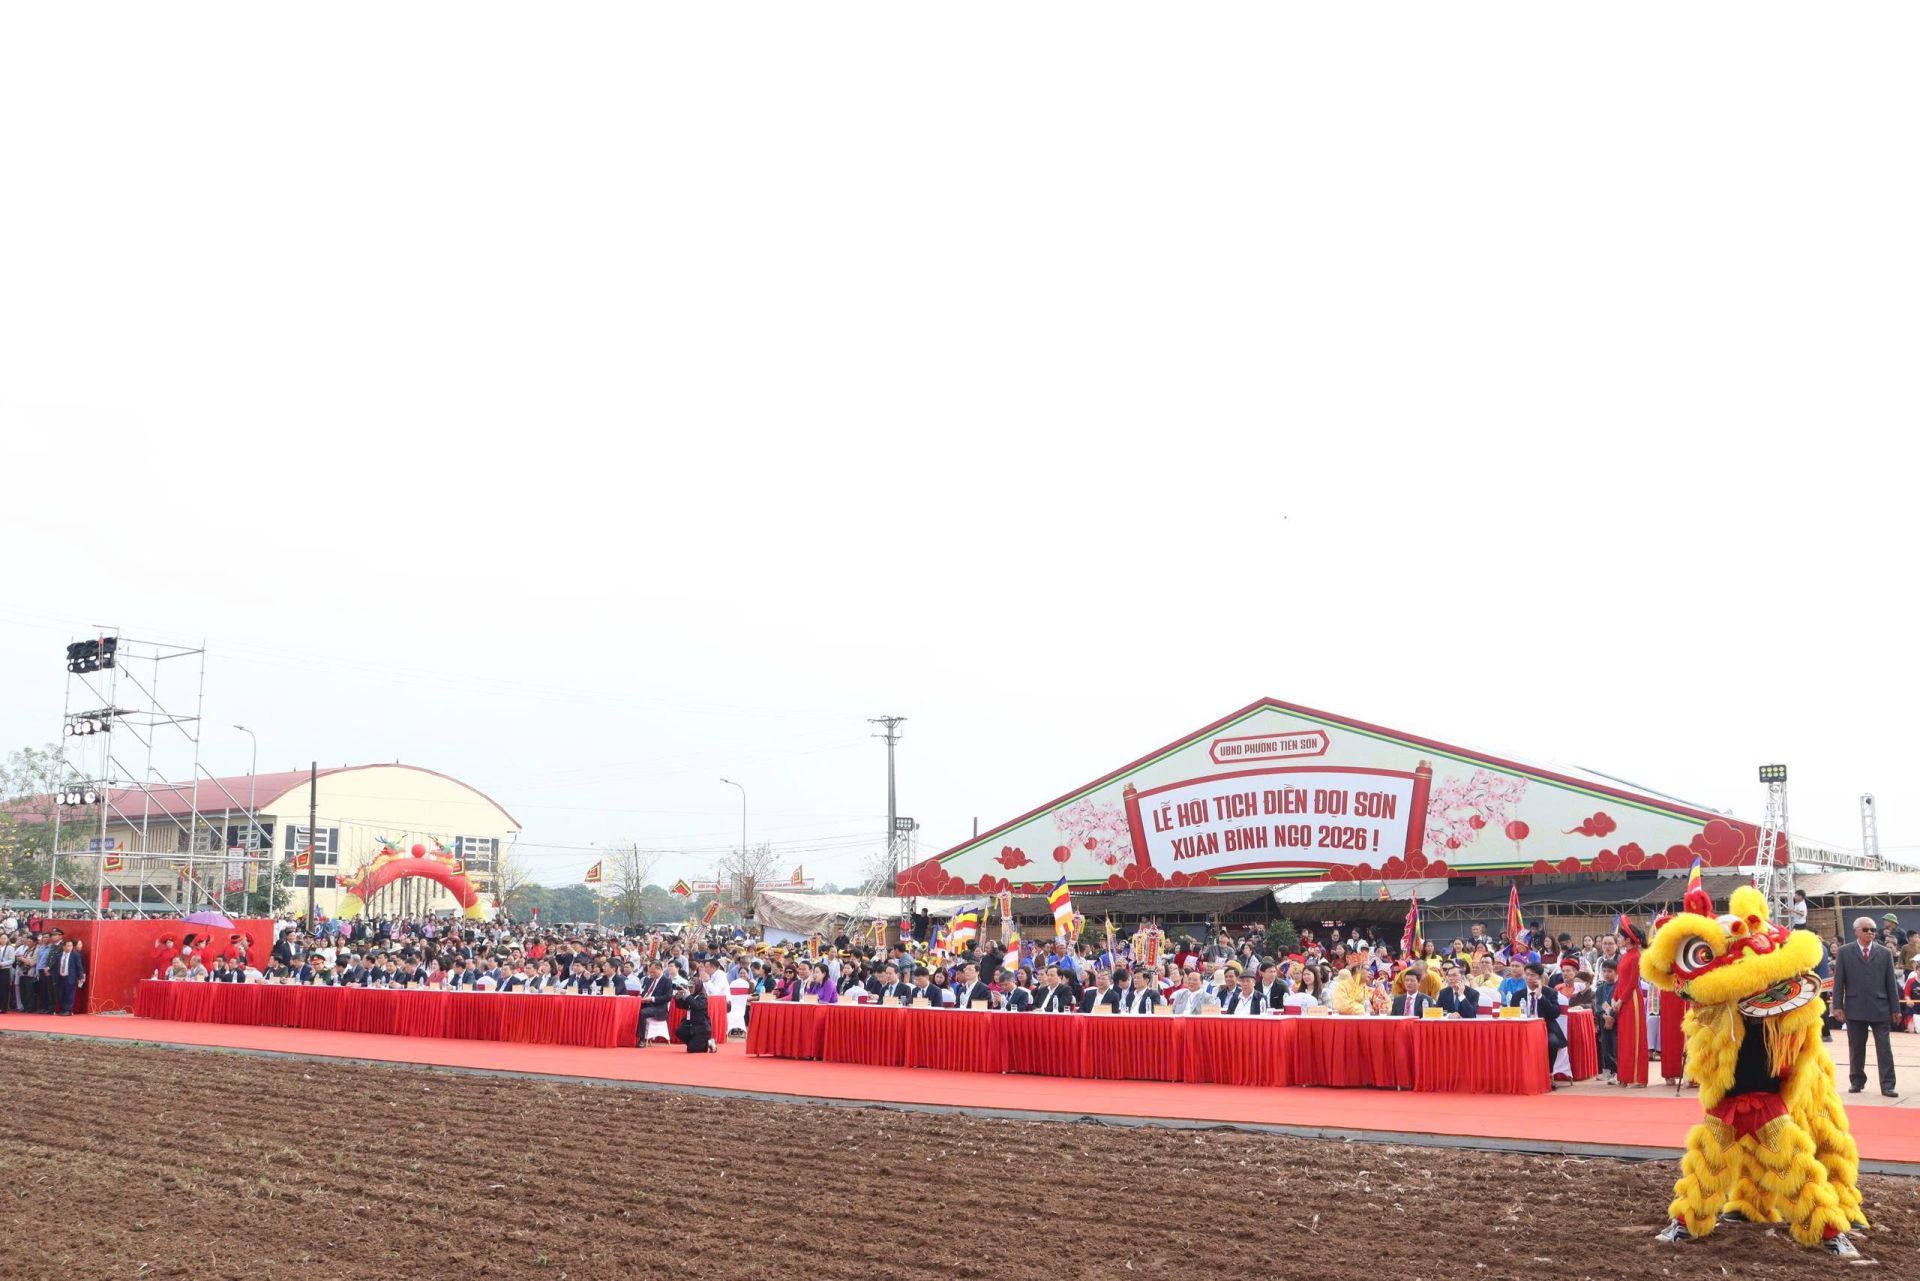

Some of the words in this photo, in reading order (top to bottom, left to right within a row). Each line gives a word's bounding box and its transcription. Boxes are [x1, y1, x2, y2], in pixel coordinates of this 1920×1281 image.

[1220, 745, 1242, 757] UBND
[1153, 800, 1174, 833] LỄ
[1176, 798, 1209, 828] HỘI
[1213, 792, 1258, 823] TỊCH
[1263, 784, 1308, 815] ĐIỀN
[1314, 789, 1348, 818] ĐỌI
[1354, 791, 1397, 820] SƠN
[1171, 832, 1220, 861] XUÂN
[1224, 825, 1268, 852] BÍNH
[1274, 824, 1312, 850] NGỌ
[1318, 825, 1367, 851] 2026
